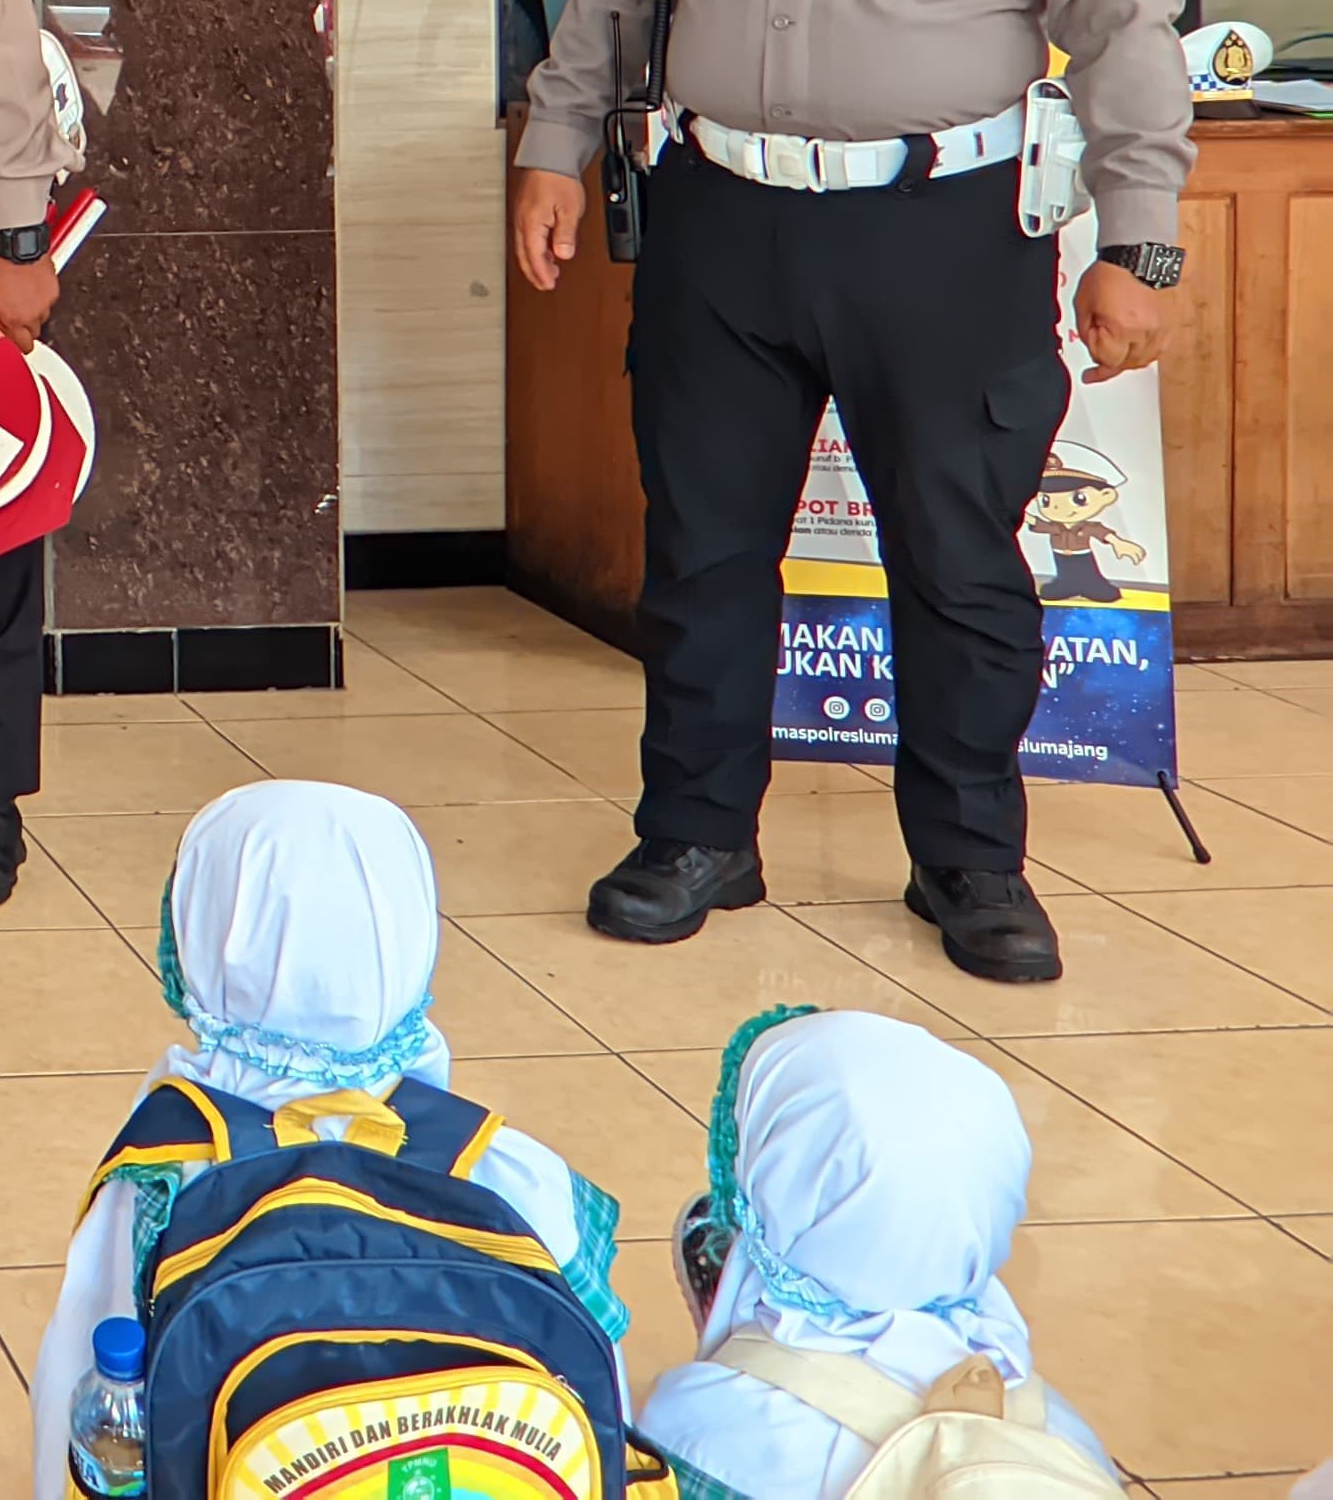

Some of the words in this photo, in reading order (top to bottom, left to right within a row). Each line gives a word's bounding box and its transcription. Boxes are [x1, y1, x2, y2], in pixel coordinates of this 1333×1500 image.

[1048, 635, 1149, 671] ATAN,
[263, 1436, 348, 1494] MANDIRI
[352, 1423, 392, 1450] DAN
[397, 1405, 510, 1436] BERAKHLAK
[510, 1419, 563, 1462] MULIA
